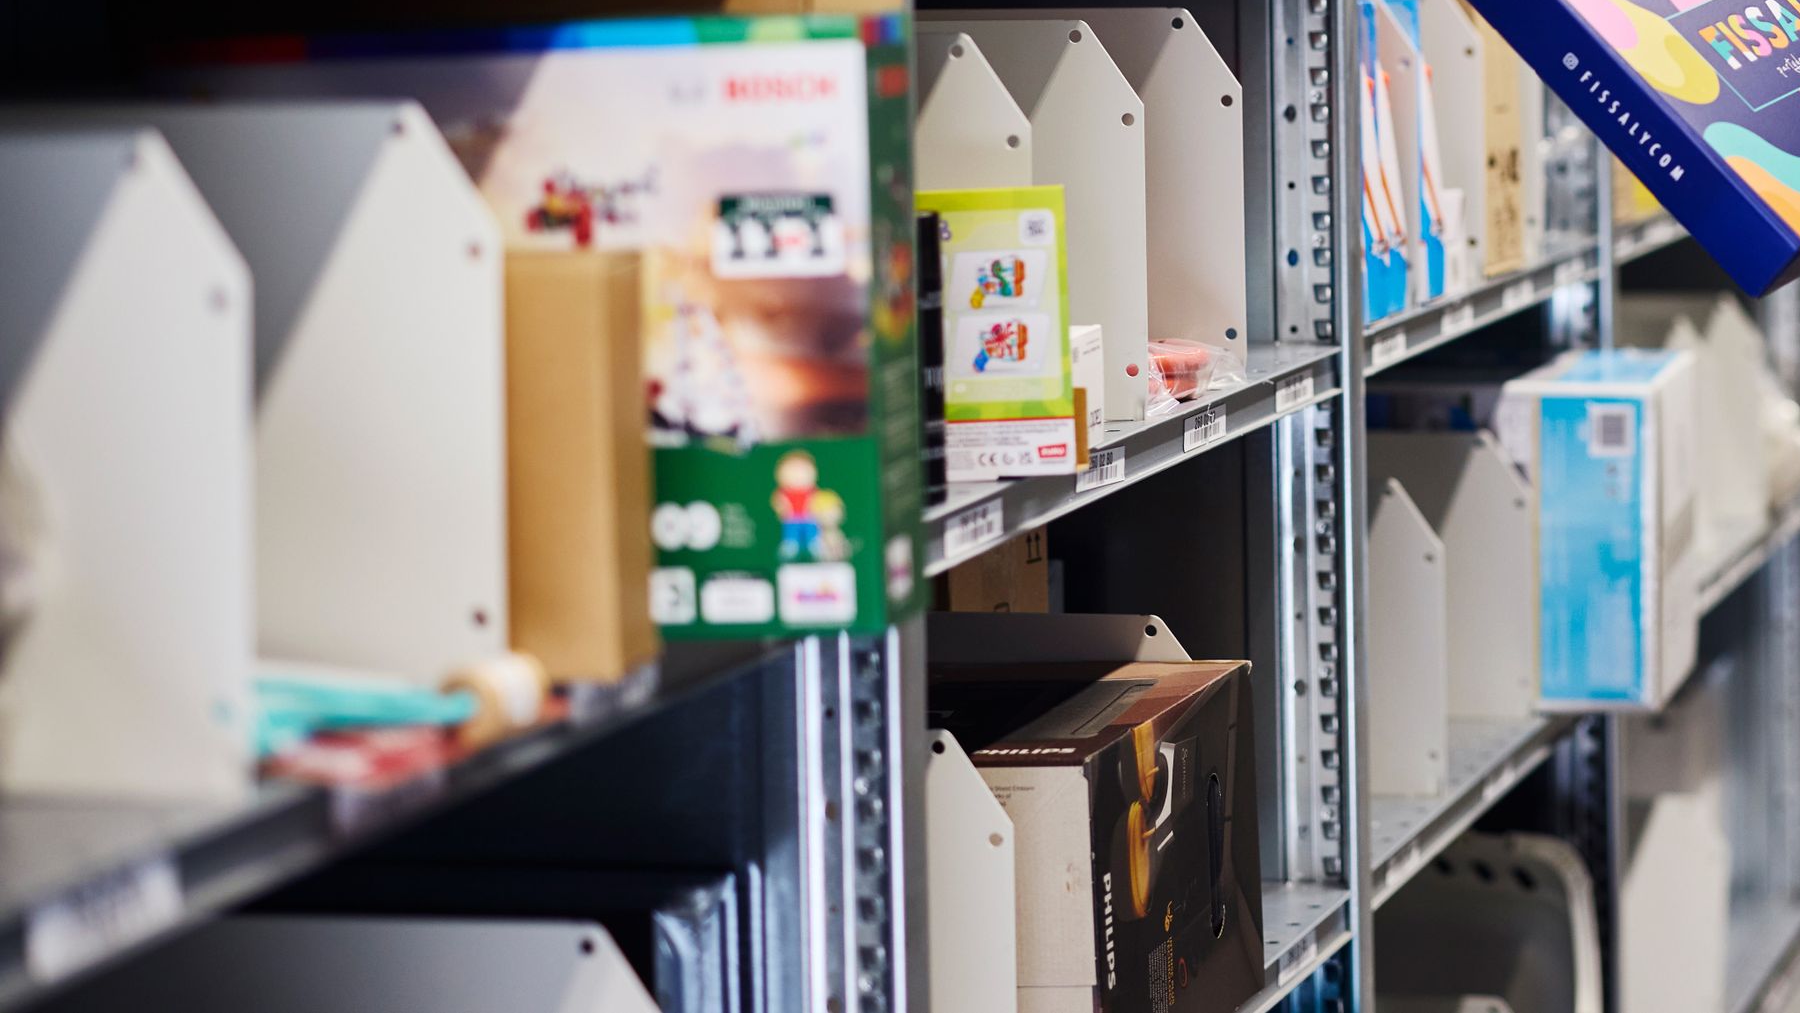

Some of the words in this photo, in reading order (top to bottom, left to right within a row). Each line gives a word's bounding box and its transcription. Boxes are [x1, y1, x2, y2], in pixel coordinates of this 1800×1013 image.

[1580, 70, 1685, 181] FISSALYCOM
[1099, 453, 1106, 468] 02
[973, 747, 1076, 755] PHILIPS
[1103, 872, 1116, 990] PHILIPS
